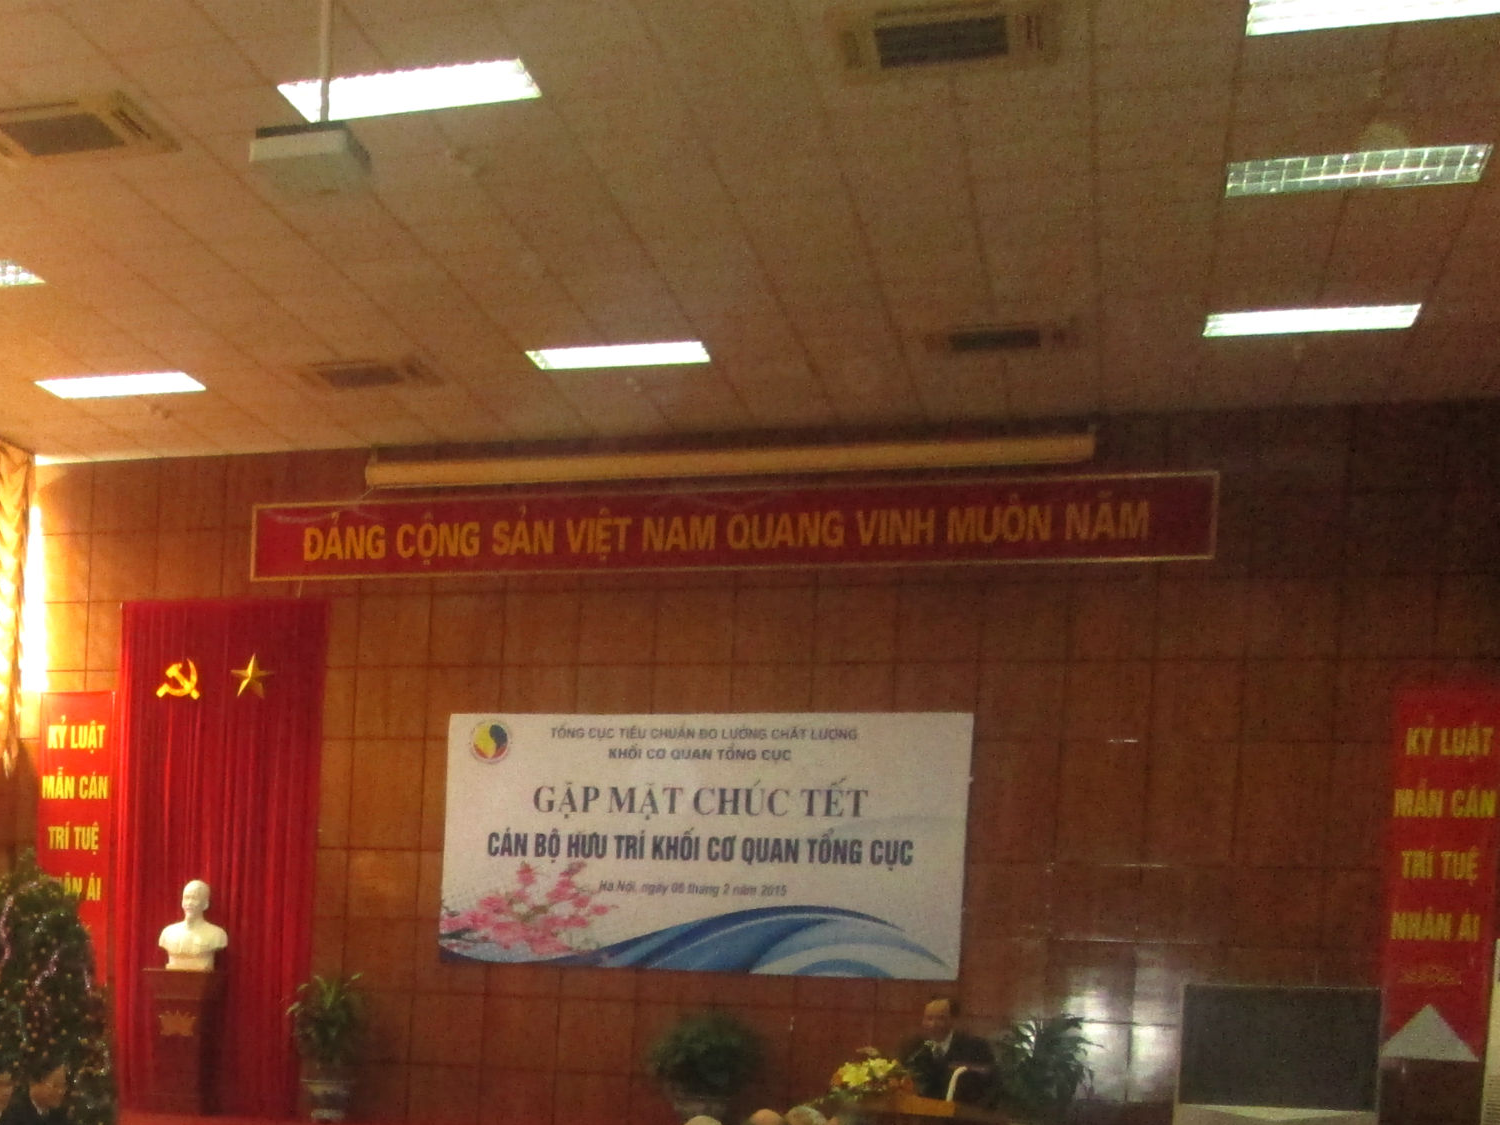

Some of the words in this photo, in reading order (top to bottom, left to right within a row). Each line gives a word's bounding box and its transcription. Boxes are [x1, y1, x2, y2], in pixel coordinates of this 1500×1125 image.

[303, 512, 386, 561] ĐẢNG
[396, 512, 480, 566] CỘNG
[492, 505, 554, 556] SẢN
[566, 507, 632, 561] VIỆT
[641, 515, 716, 552] NAM
[727, 510, 845, 550] QUANG
[856, 508, 935, 546] VINH
[947, 493, 1051, 544] MUÔN
[48, 715, 67, 749] KỶ
[70, 720, 105, 754] LUẬT
[1440, 721, 1494, 763] LUẬT
[670, 748, 712, 761] QUAN
[42, 767, 75, 799] MẪN
[79, 772, 108, 799] CÁN
[532, 780, 600, 820] GẶP
[608, 781, 684, 821] MẶT
[692, 778, 789, 817] CHÚC
[800, 775, 869, 818] TẾT
[1451, 784, 1498, 818] CÁN
[48, 821, 70, 850] TRÍ
[74, 822, 99, 855] TUỆ
[487, 827, 528, 857] CÁN
[534, 827, 561, 863] BỘ
[615, 829, 645, 860] TRÍ
[652, 827, 700, 862] KHỐI
[707, 835, 737, 862] CƠ
[742, 837, 800, 865] QUAN
[806, 827, 862, 865] TỔNG
[870, 839, 914, 871] CỤC
[1402, 845, 1434, 879] TRÍ
[1440, 846, 1480, 886] TUỆ
[87, 872, 102, 901] ÁI
[1390, 906, 1452, 940] NHÂN
[1458, 907, 1481, 942] ÁI
